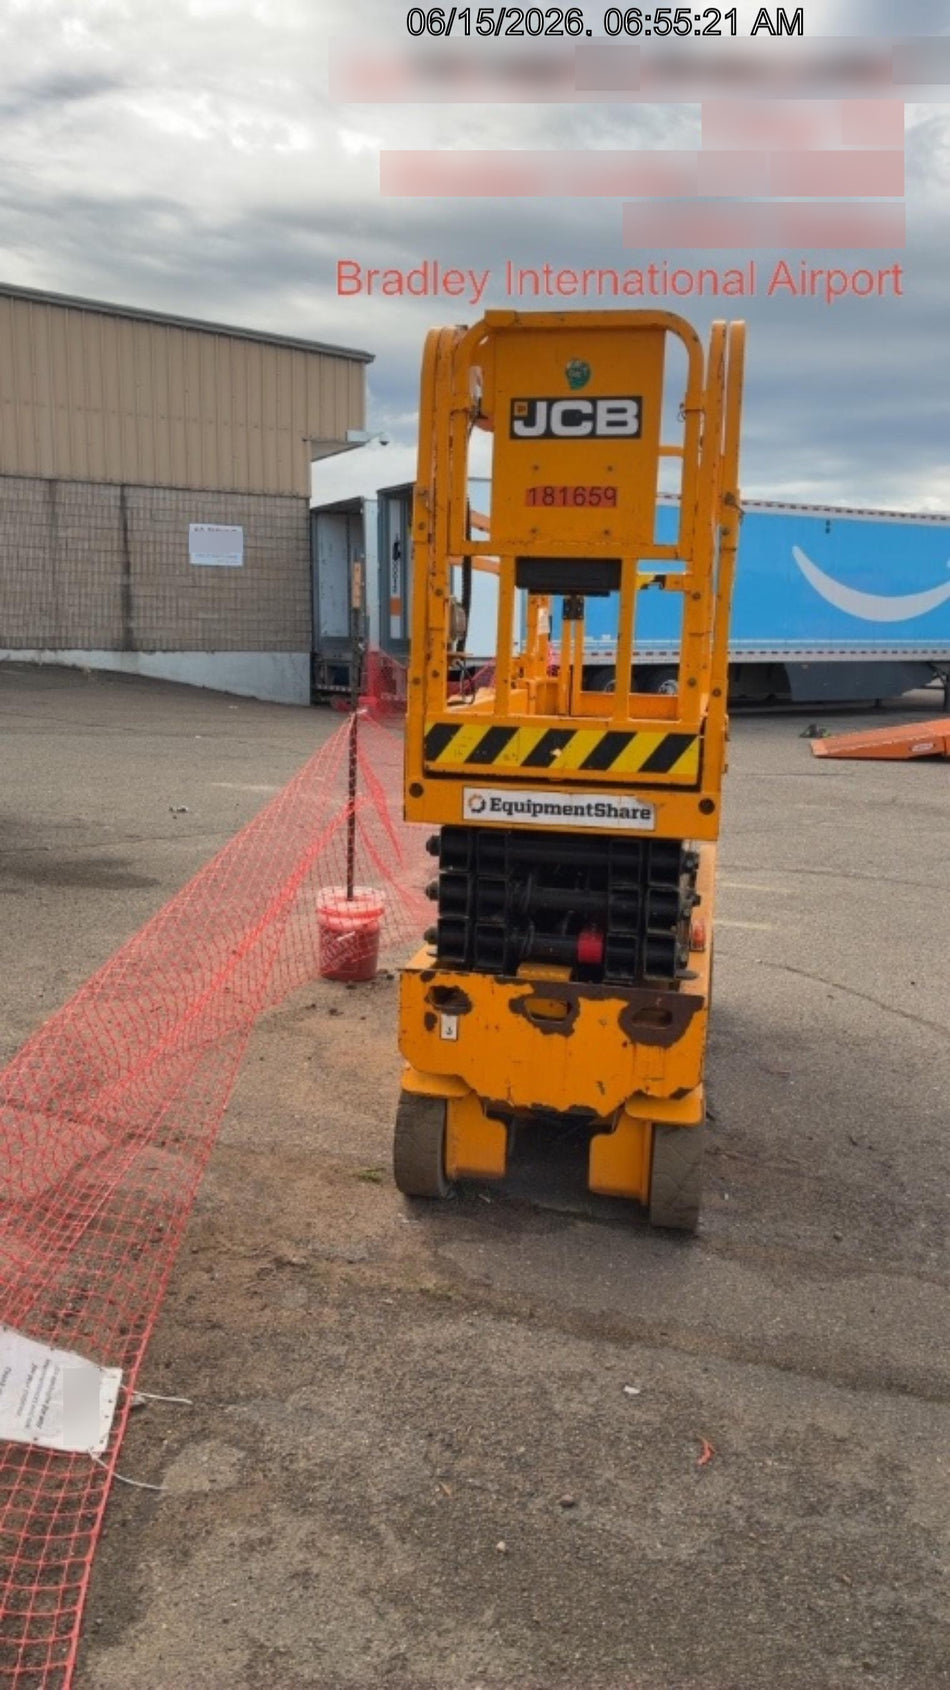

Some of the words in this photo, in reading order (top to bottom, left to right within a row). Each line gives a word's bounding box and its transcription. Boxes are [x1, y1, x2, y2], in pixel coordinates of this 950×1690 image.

[513, 399, 639, 436] JCB
[528, 486, 617, 506] 181659
[489, 797, 652, 820] EquipmentShare
